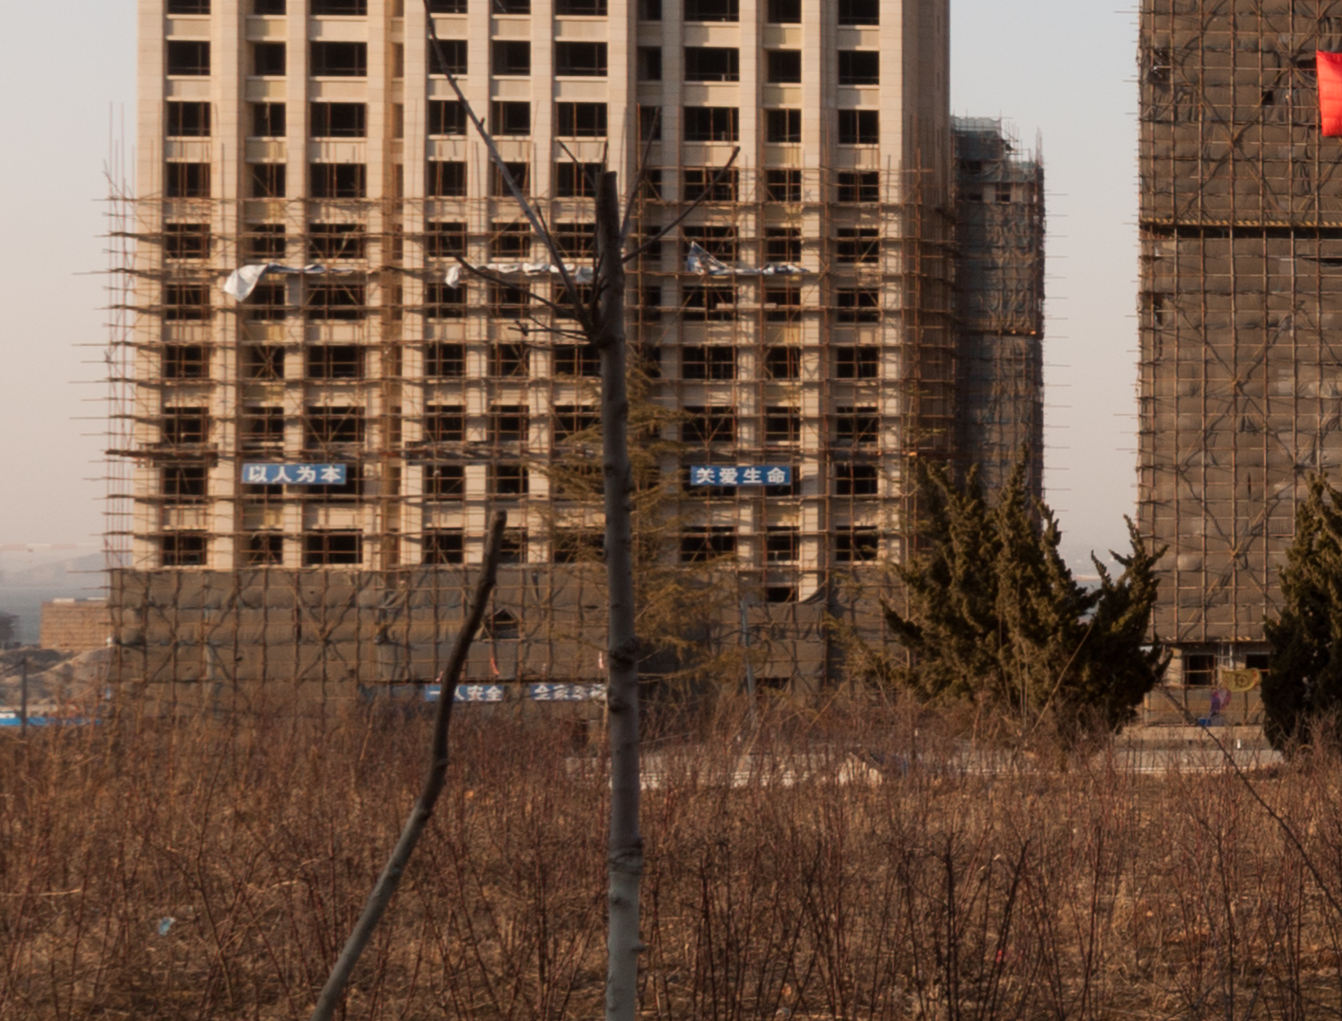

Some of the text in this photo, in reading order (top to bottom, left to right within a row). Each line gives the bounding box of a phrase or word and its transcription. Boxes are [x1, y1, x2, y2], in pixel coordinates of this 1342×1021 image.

[247, 466, 342, 484] 以人为本
[696, 467, 789, 486] 关爱生命
